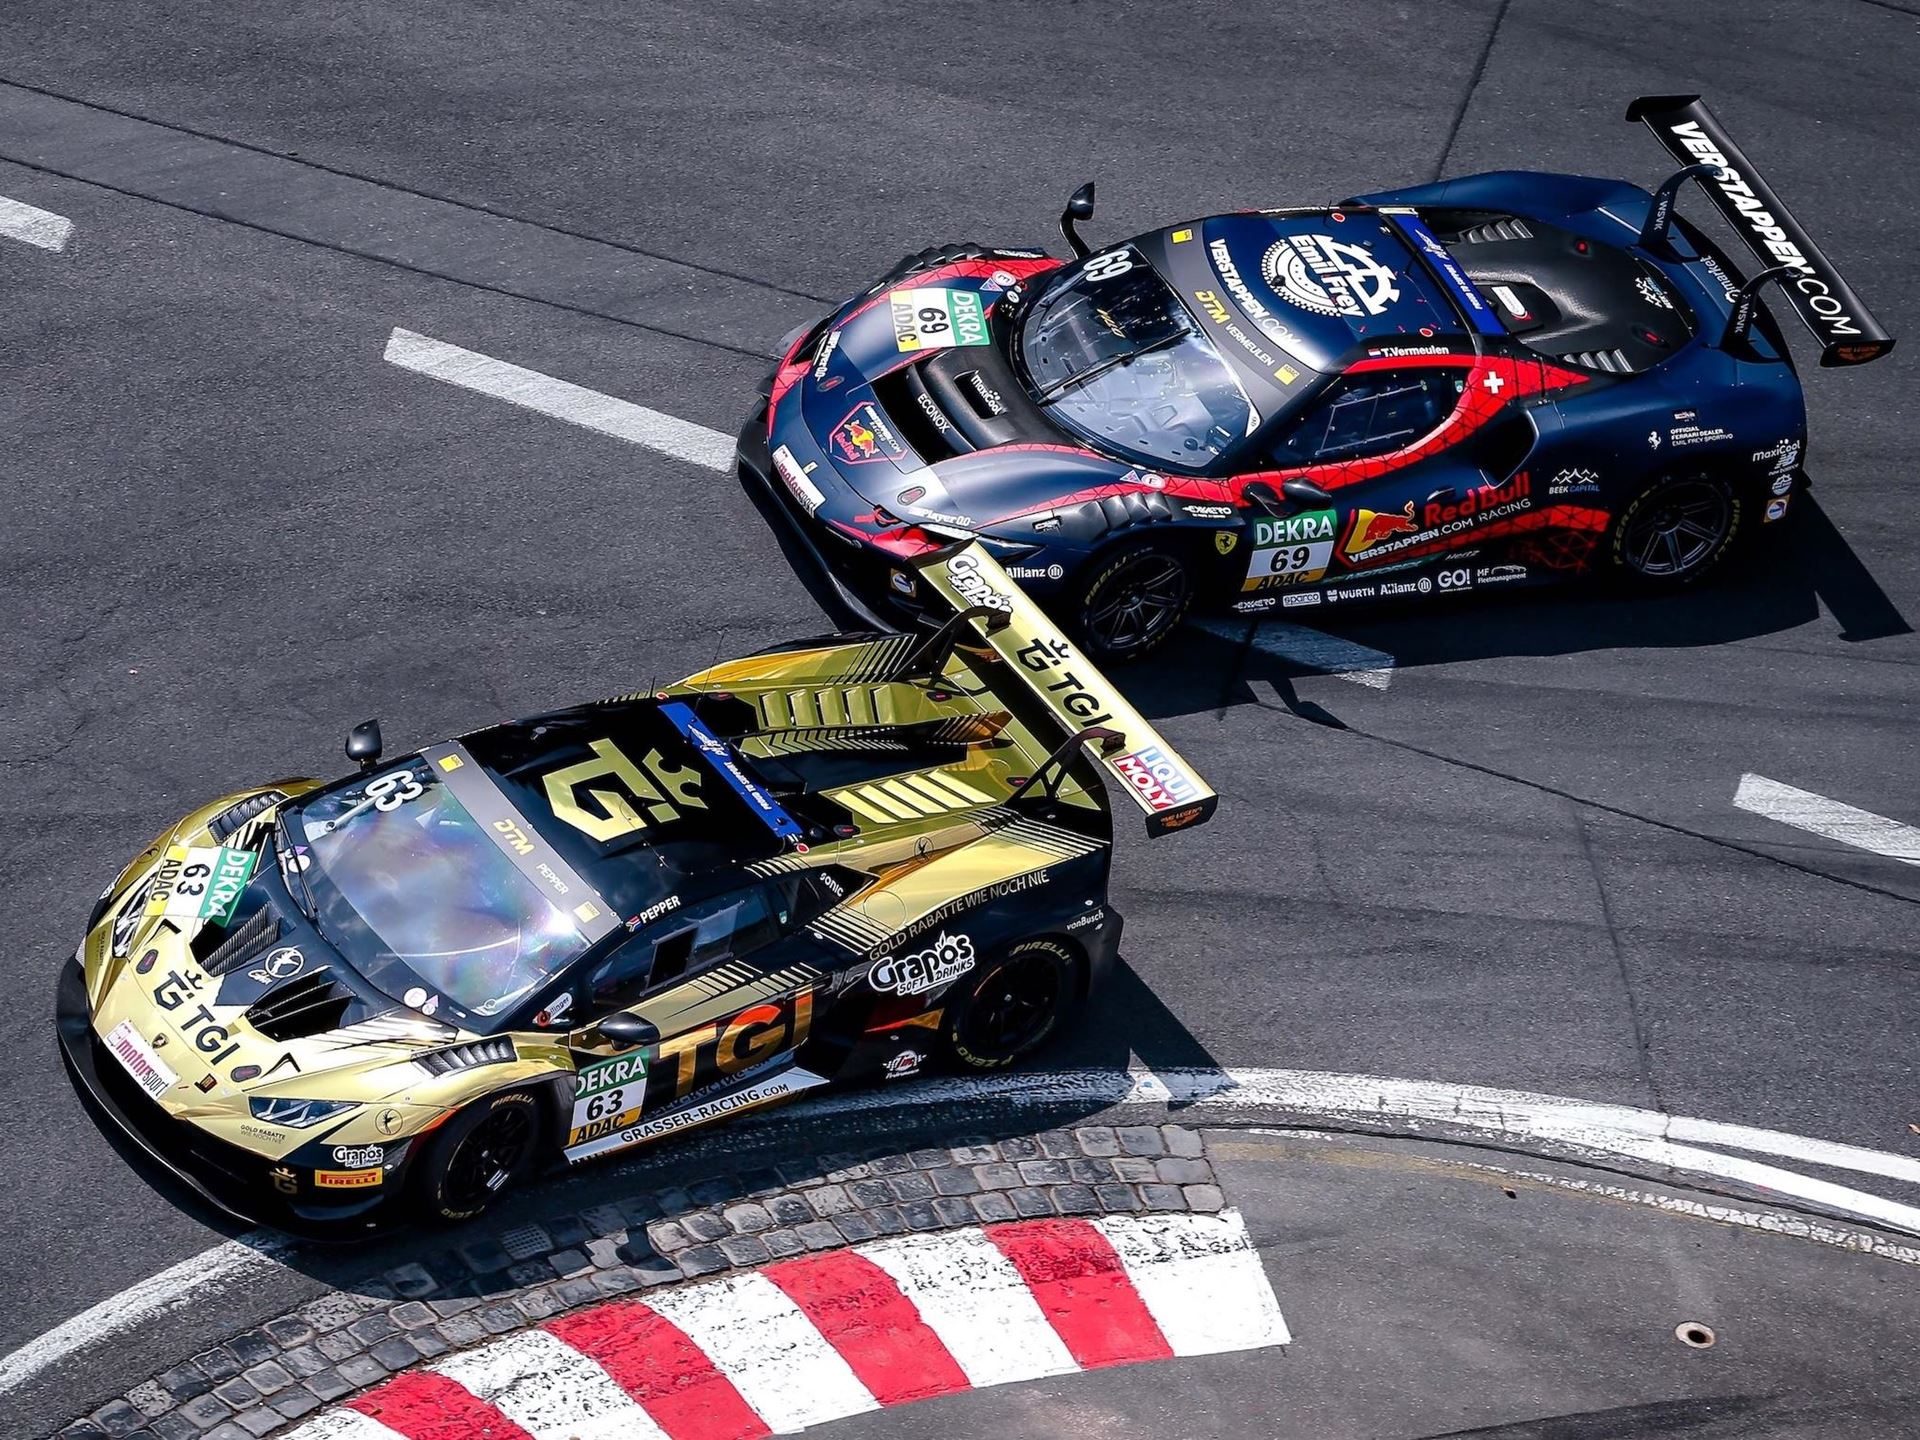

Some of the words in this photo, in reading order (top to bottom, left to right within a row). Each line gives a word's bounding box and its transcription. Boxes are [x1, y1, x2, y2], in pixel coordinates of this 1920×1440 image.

[1653, 200, 1669, 231] WSVK
[1670, 120, 1862, 335] VERSTAPPEN.COM
[1083, 249, 1133, 282] 69
[1288, 235, 1341, 274] Emil
[1321, 275, 1366, 317] Frey
[1195, 290, 1231, 324] DTM
[1209, 238, 1302, 346] VERSTAPPEN.COM
[892, 303, 918, 344] ADAC
[917, 306, 950, 335] 69
[950, 291, 985, 346] DEKRA
[1734, 303, 1749, 334] WSVK
[1224, 323, 1276, 367] VERMEULEN
[1381, 345, 1450, 357] T.Vermeulen
[970, 370, 1004, 415] maxiCool
[917, 393, 951, 433] ECONOX
[1670, 426, 1699, 434] OFFICIAL
[1699, 428, 1723, 437] DEALER
[1752, 438, 1801, 462] maxiCool
[1424, 488, 1476, 527] Red
[1477, 472, 1531, 511] Bull
[1549, 484, 1569, 494] BEEK
[1569, 484, 1600, 493] CAPITAL
[1256, 516, 1334, 546] DEKRA
[1349, 518, 1474, 563] VERSTAPPEN.COM
[1479, 498, 1531, 523] RACING
[1005, 566, 1046, 578] Allianz
[1269, 546, 1310, 572] 69
[1477, 568, 1490, 578] MF
[1256, 571, 1310, 589] ADAC
[1380, 583, 1416, 595] Allianz
[1438, 568, 1471, 588] GO!
[1477, 572, 1526, 584] Fleetmanagement
[1047, 671, 1114, 728] TGI
[1118, 756, 1176, 810] MOLY
[1139, 746, 1198, 798] LIQUI
[364, 770, 423, 811] 63
[492, 818, 535, 856] DTM
[150, 858, 183, 902] ADAC
[176, 863, 211, 896] 63
[204, 849, 246, 918] DEKRA
[535, 863, 569, 895] PEPPER
[640, 895, 681, 923] PEPPER
[869, 931, 907, 961] GOLD
[908, 898, 965, 939] RABATTE
[965, 889, 989, 908] WIE
[989, 877, 1027, 900] NOCH
[1028, 869, 1050, 888] NIE
[1066, 910, 1104, 931] vonBusch
[899, 977, 925, 995] SOFT
[934, 959, 974, 981] DRINKS
[181, 1004, 240, 1065] TGI
[659, 984, 813, 1098] TGI
[115, 1039, 169, 1097] motorsport
[575, 1056, 646, 1096] DEKRA
[587, 1089, 624, 1121] 63
[620, 1083, 790, 1144] GRASSER-RACING.COM
[240, 1125, 258, 1133] GOLD
[258, 1128, 286, 1140] RABATTE
[574, 1113, 626, 1144] ADAC
[320, 1171, 378, 1185] PIRELLI
